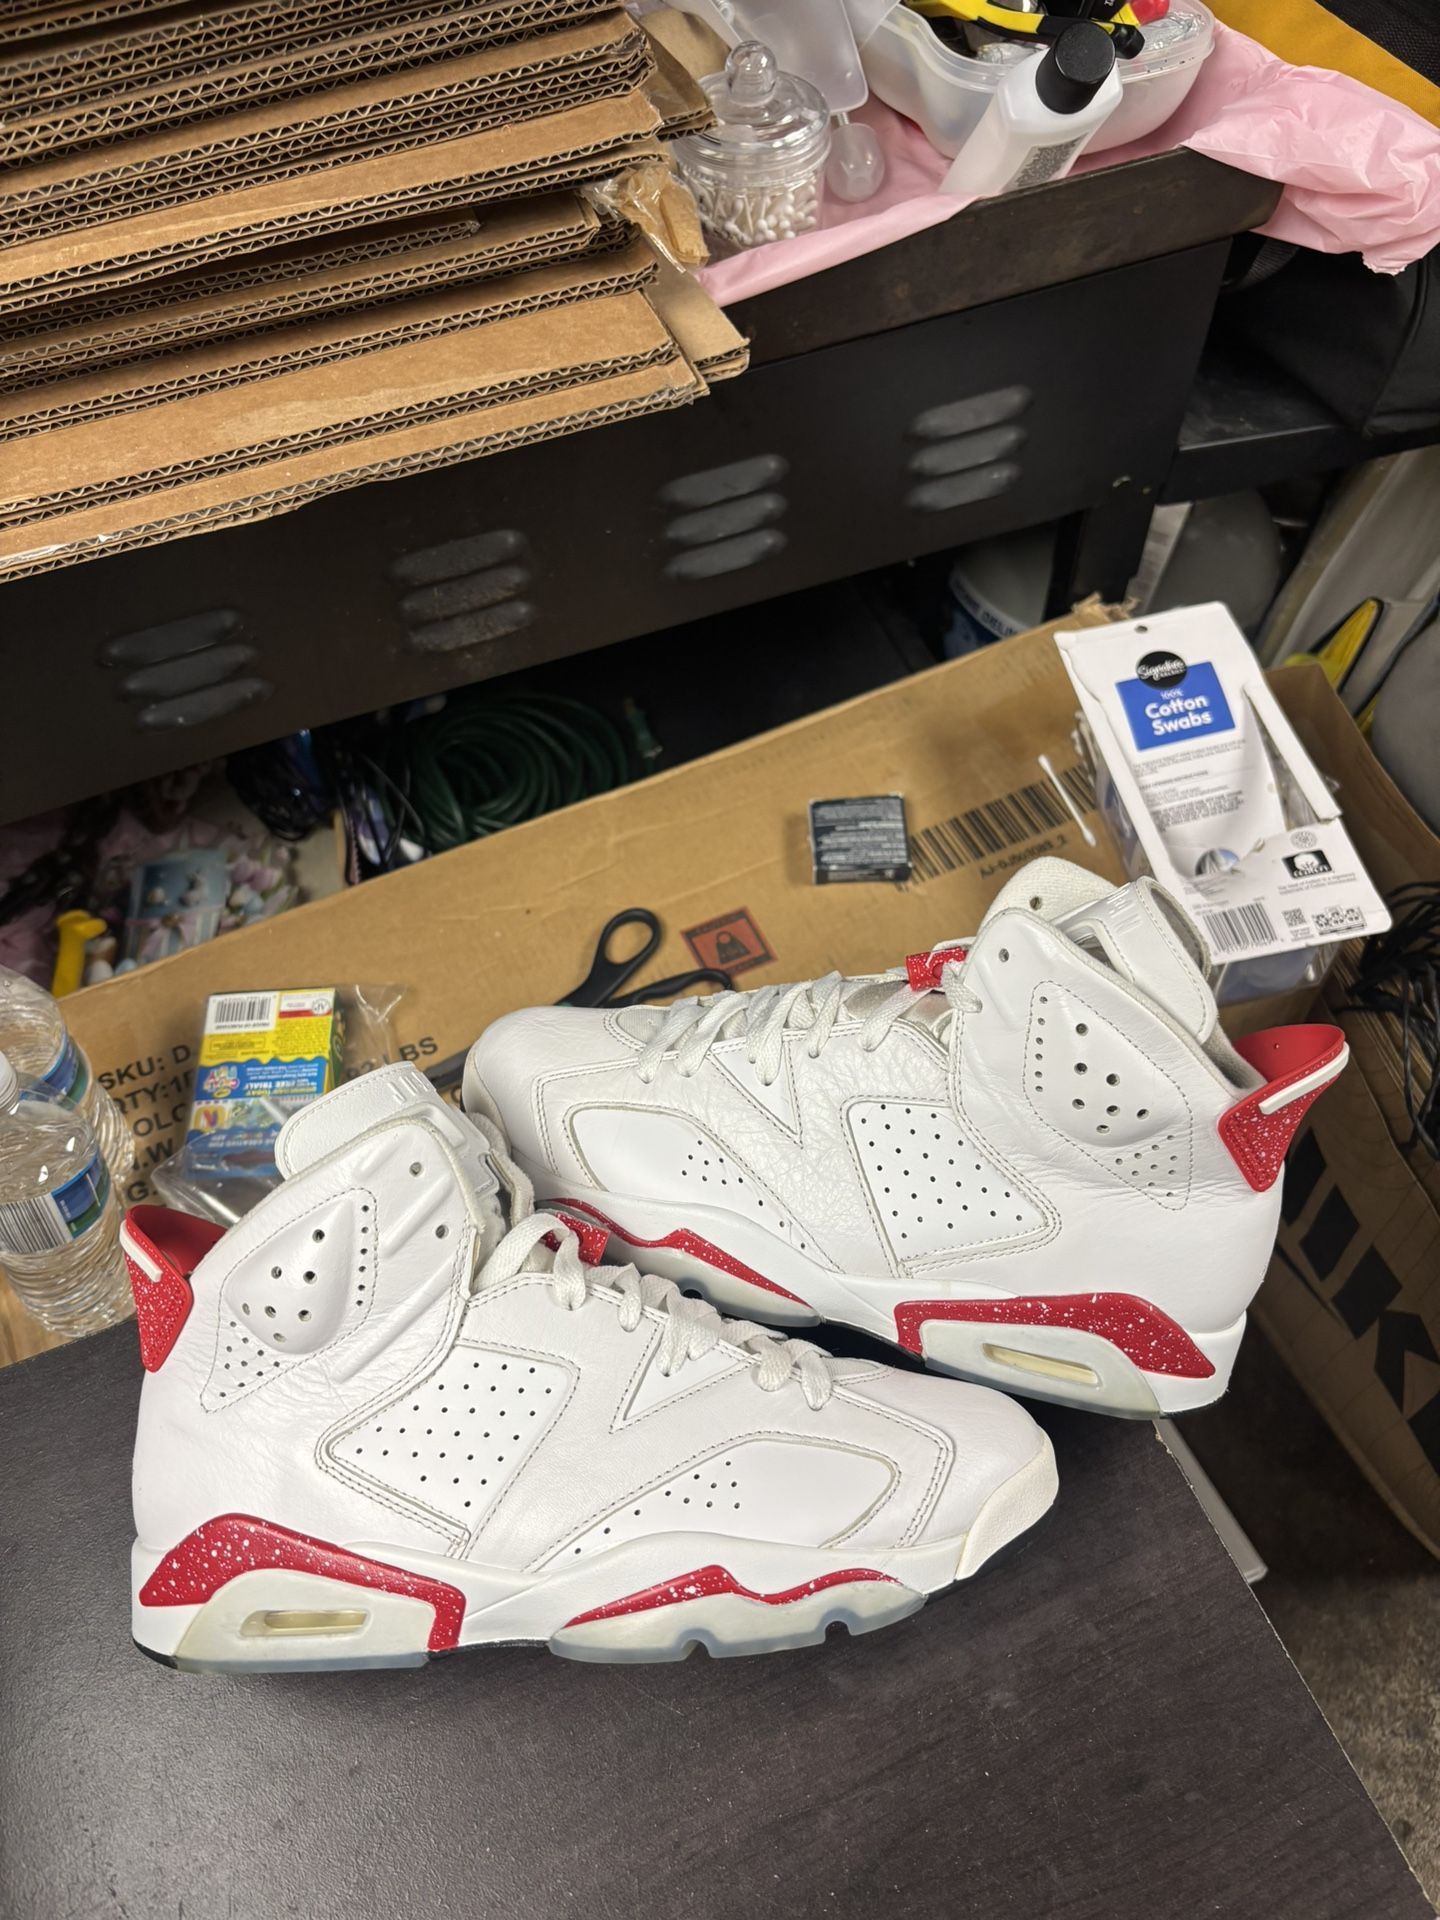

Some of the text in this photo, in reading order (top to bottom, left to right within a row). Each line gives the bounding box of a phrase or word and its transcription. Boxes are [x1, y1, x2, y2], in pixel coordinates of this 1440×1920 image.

[1144, 695, 1209, 719] Cotton
[1151, 711, 1213, 736] Swabs
[98, 1057, 166, 1091] SKU:
